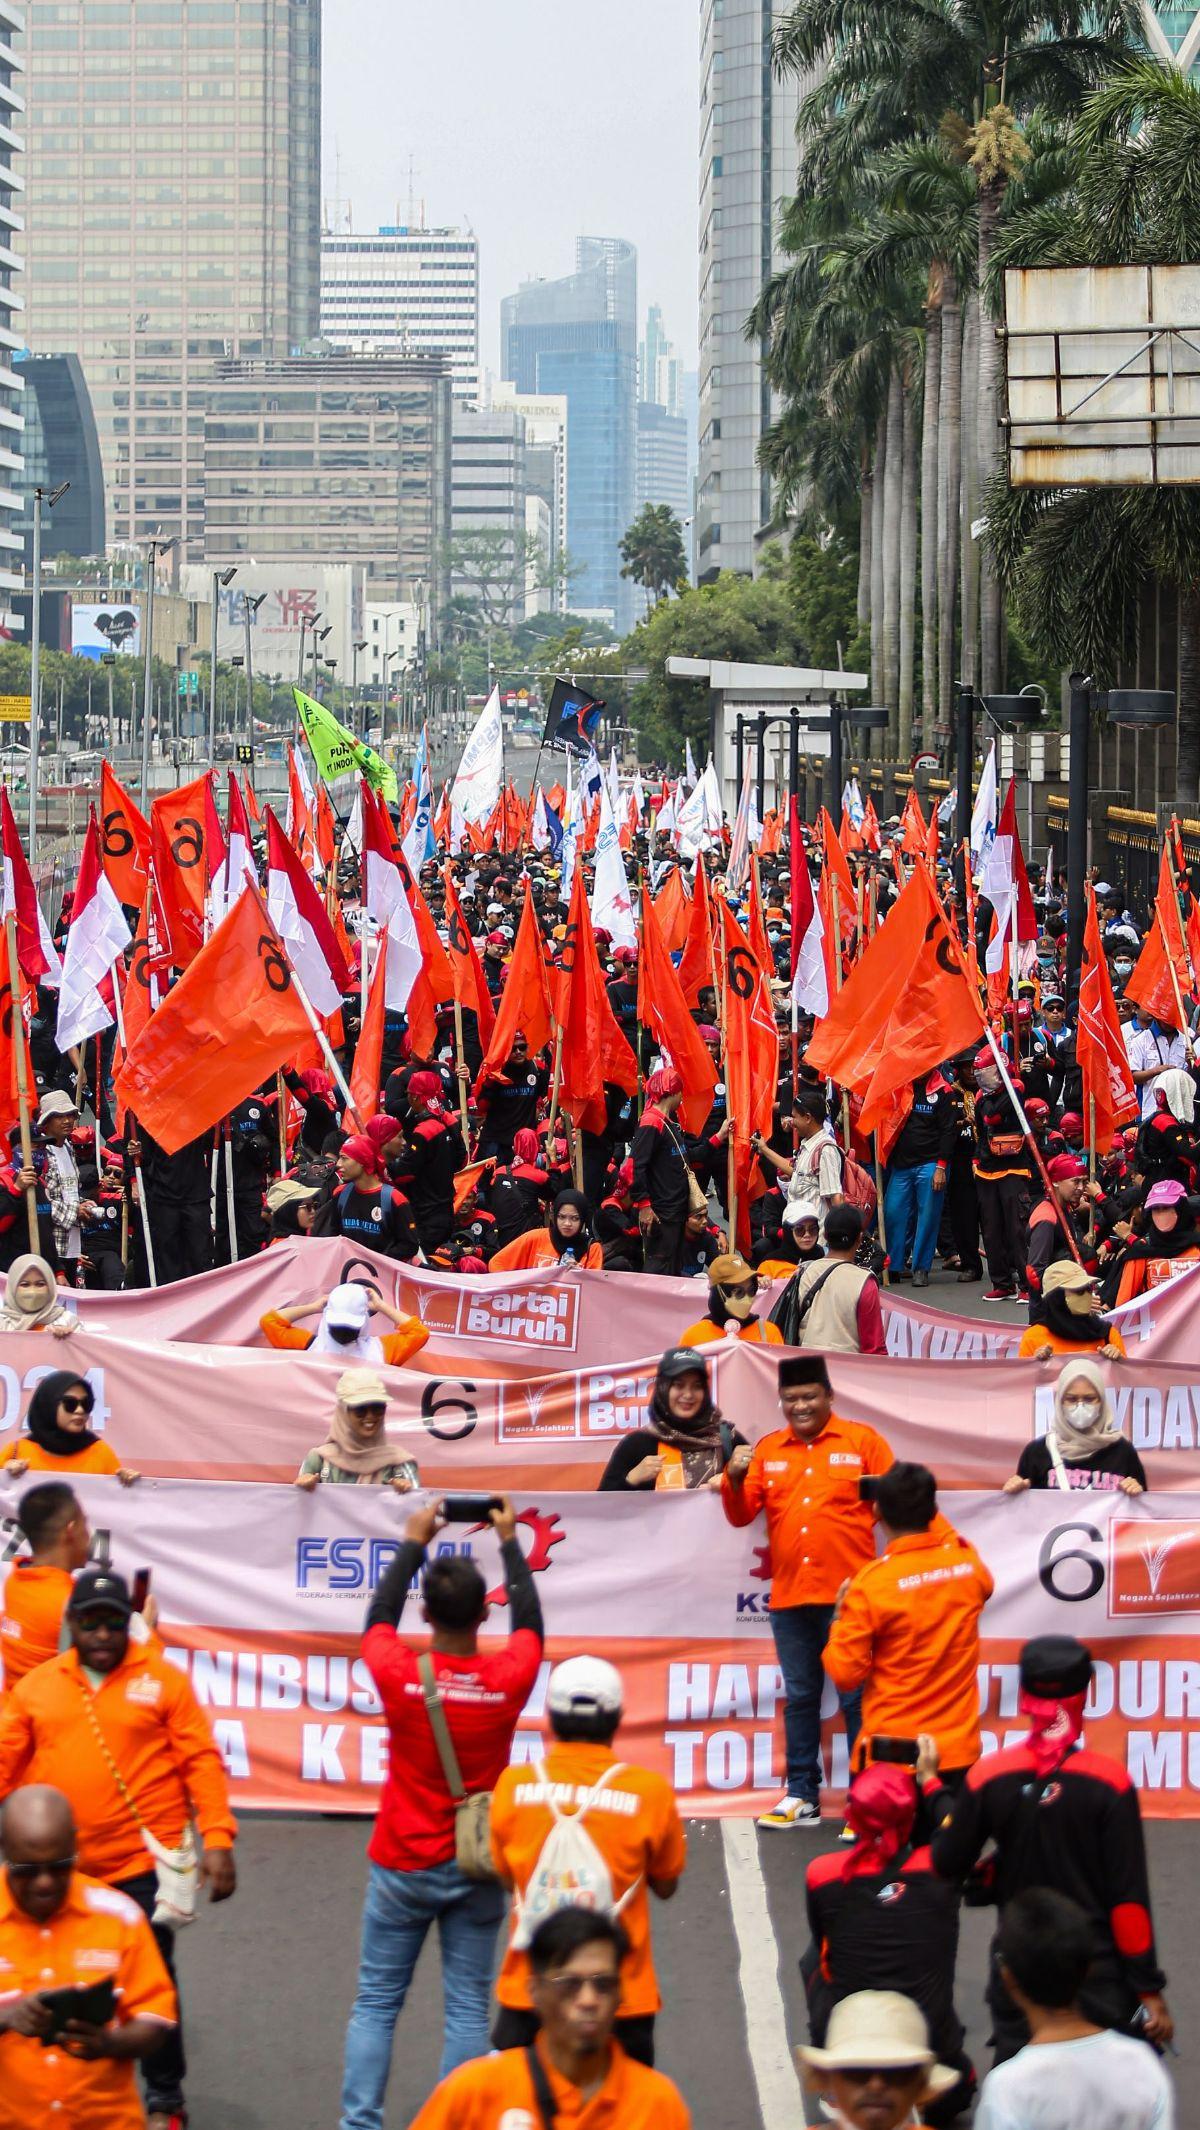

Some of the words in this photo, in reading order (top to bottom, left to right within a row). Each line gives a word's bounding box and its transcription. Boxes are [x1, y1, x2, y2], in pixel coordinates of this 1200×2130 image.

[102, 810, 134, 857] 6
[728, 946, 757, 1000] 6
[466, 1307, 567, 1342] Buruh
[470, 1290, 568, 1318] Partai
[421, 1378, 478, 1441] 6
[1039, 1521, 1105, 1602] 6
